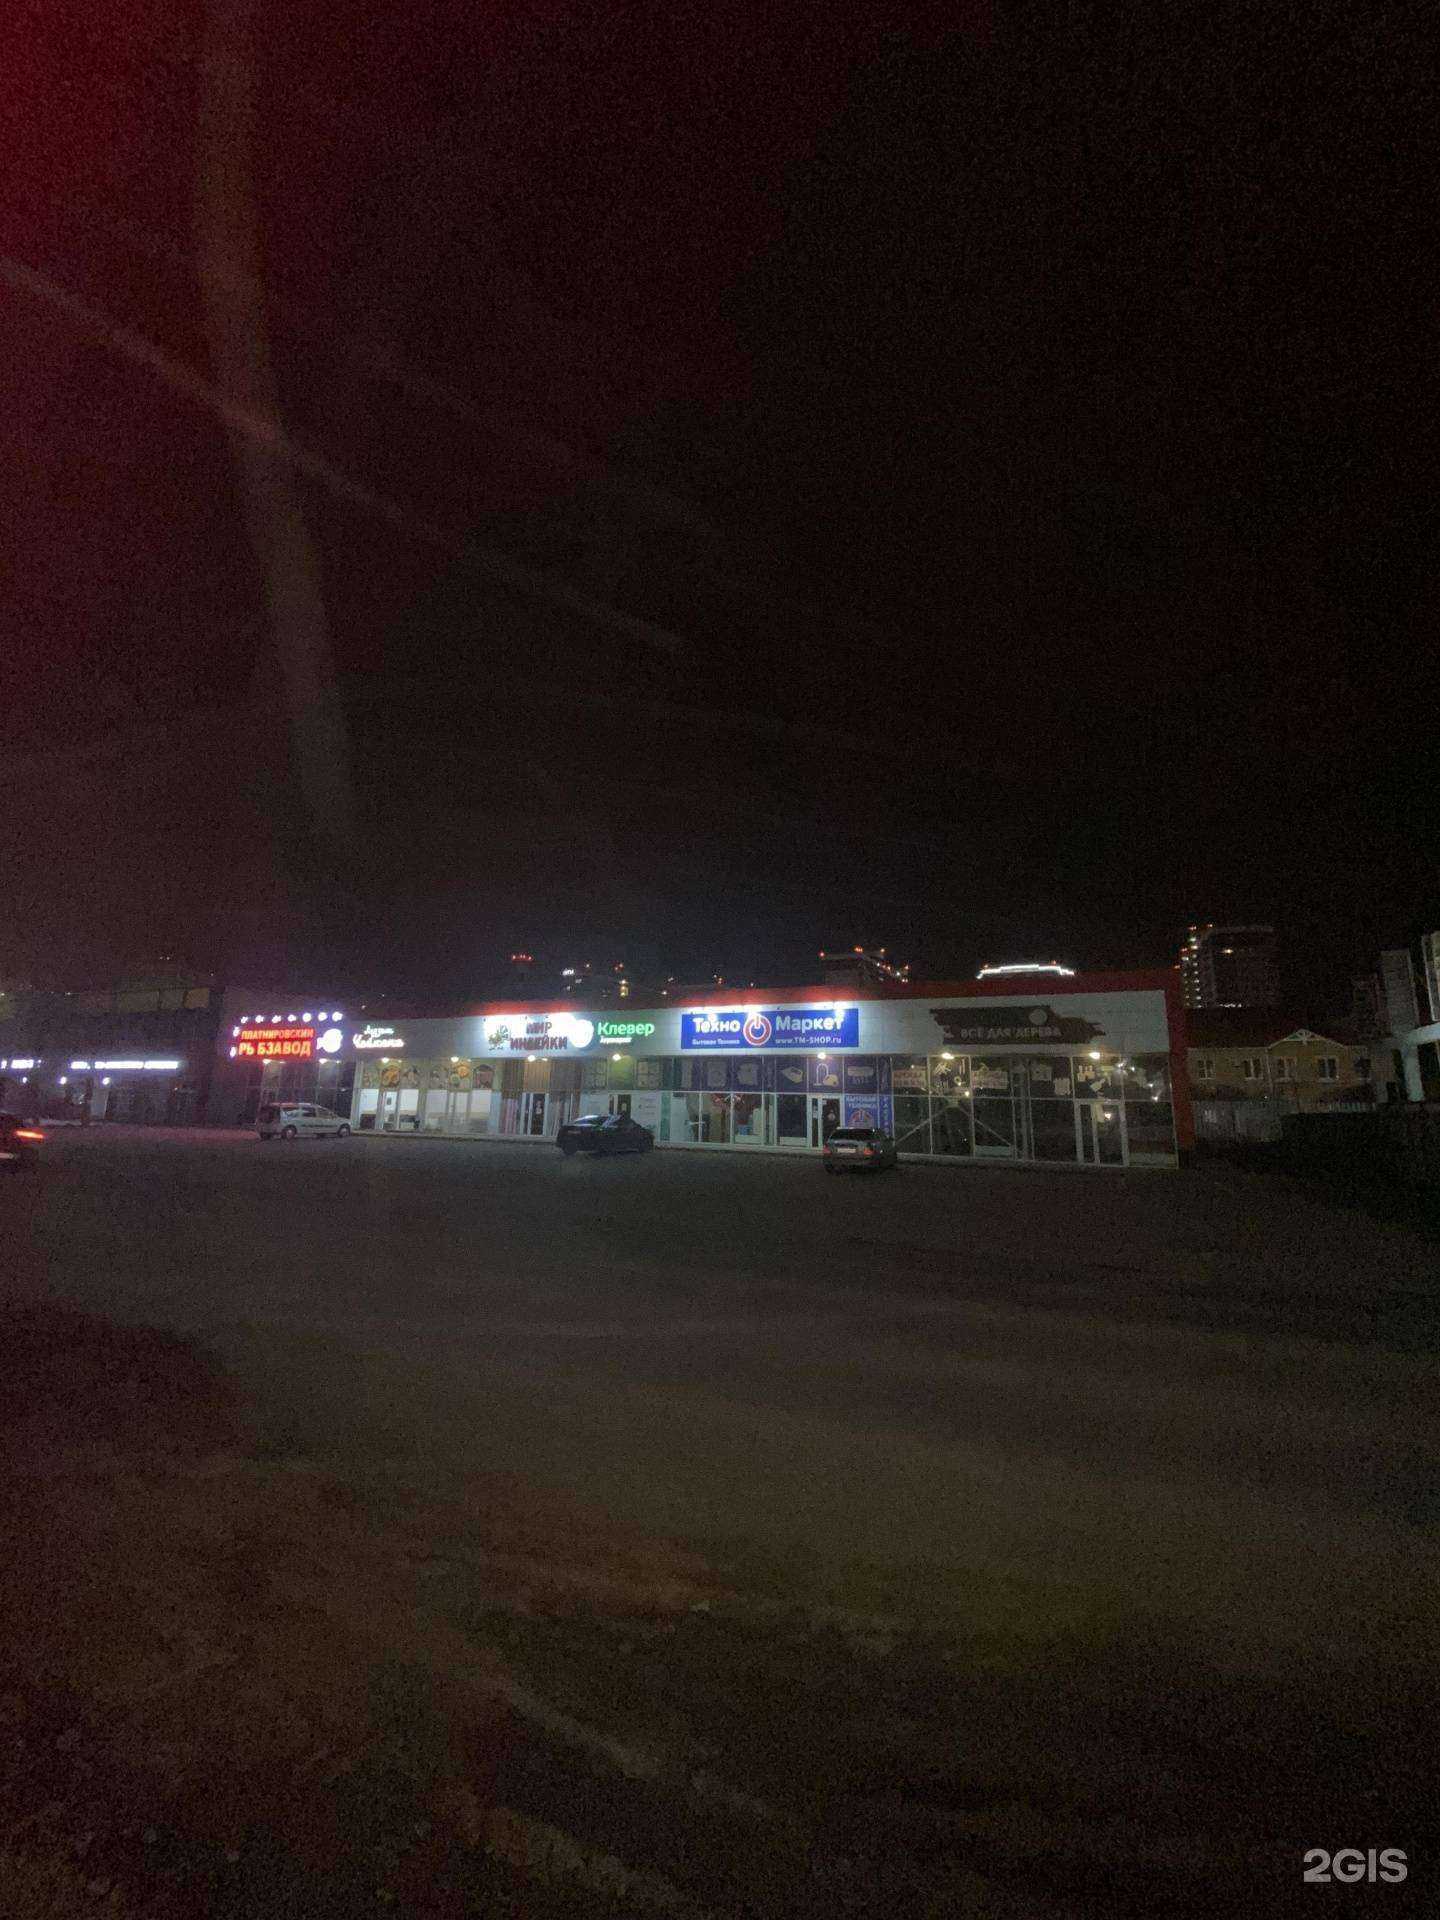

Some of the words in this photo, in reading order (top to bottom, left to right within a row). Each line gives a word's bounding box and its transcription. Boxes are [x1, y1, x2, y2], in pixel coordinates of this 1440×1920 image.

[526, 1021, 553, 1034] МИР
[597, 1021, 655, 1037] Клевер
[692, 1017, 741, 1034] Техно
[776, 1014, 844, 1034] Маркет
